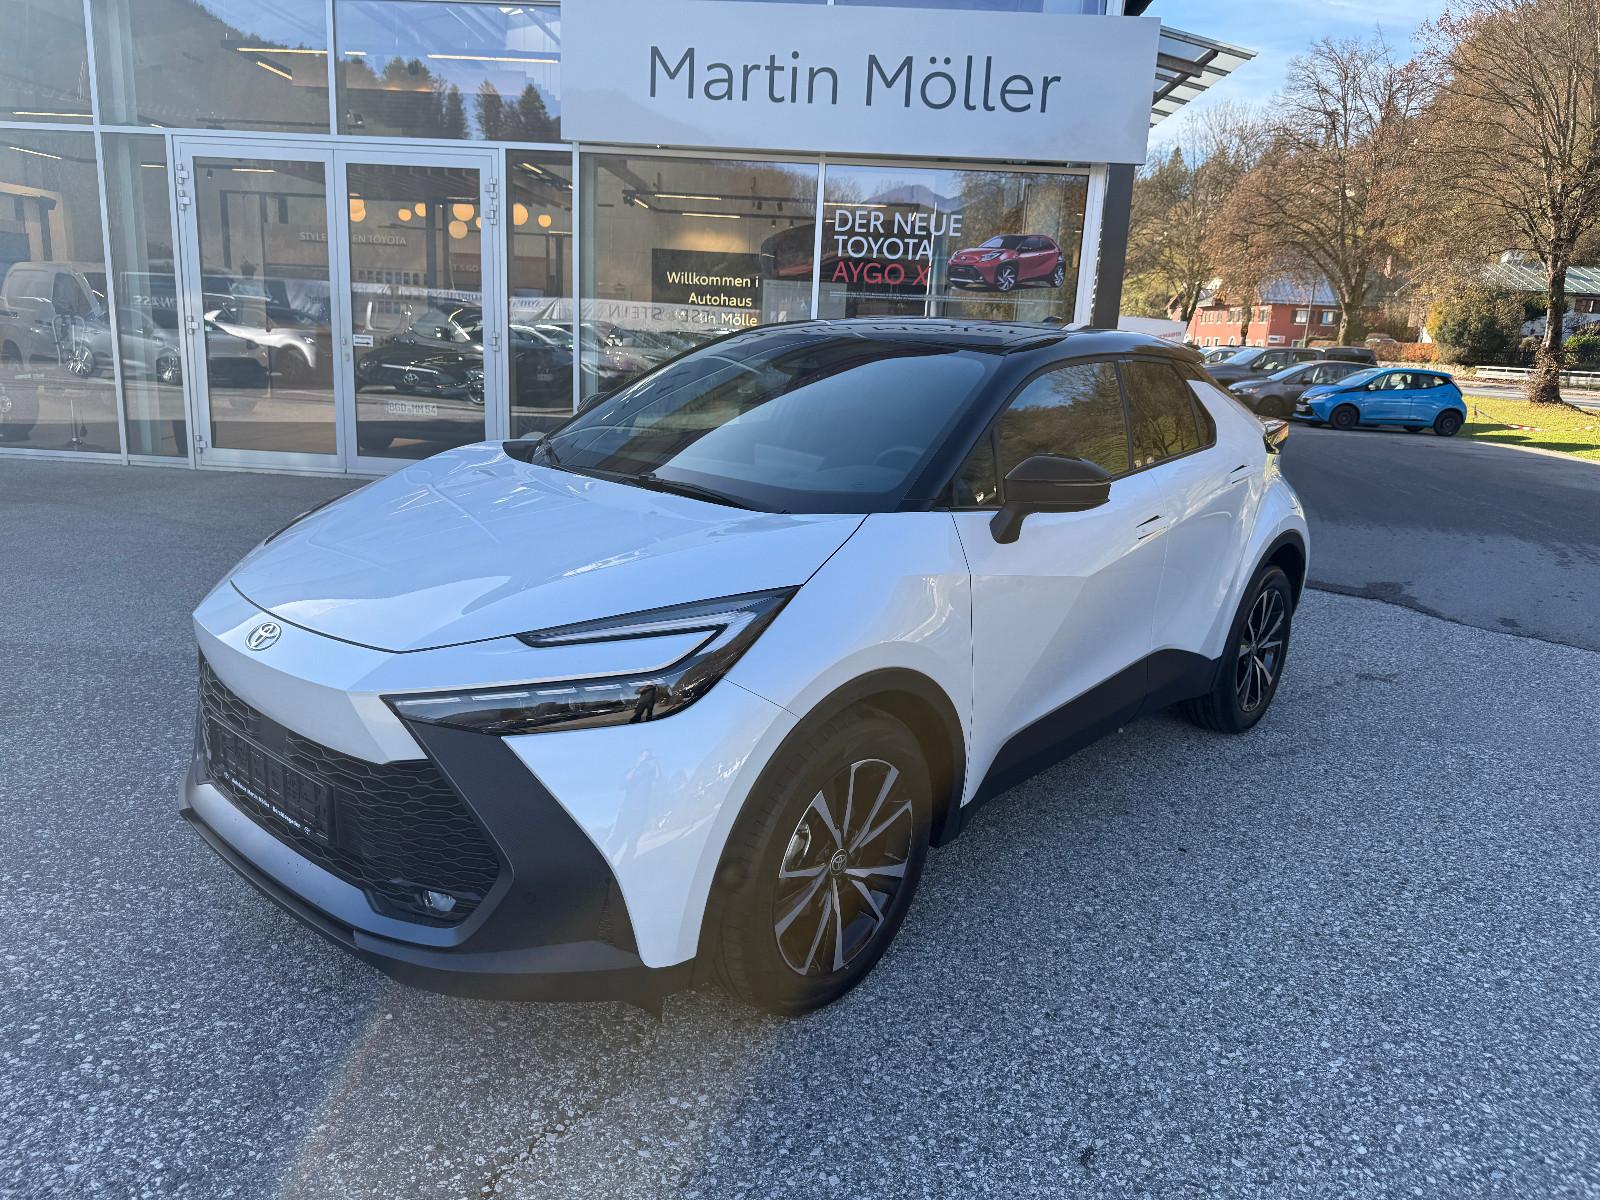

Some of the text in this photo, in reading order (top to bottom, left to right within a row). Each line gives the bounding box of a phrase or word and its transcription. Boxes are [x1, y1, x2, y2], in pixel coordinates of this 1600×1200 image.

[650, 45, 1062, 113] Martin Möller
[833, 209, 963, 237] DER NEUE
[367, 234, 407, 246] TOYOTA
[833, 235, 933, 261] TOYOTA
[666, 271, 760, 288] Willkommen i
[831, 260, 930, 286] AYGO X
[688, 291, 753, 308] Autohaus
[721, 312, 758, 327] Mölle
